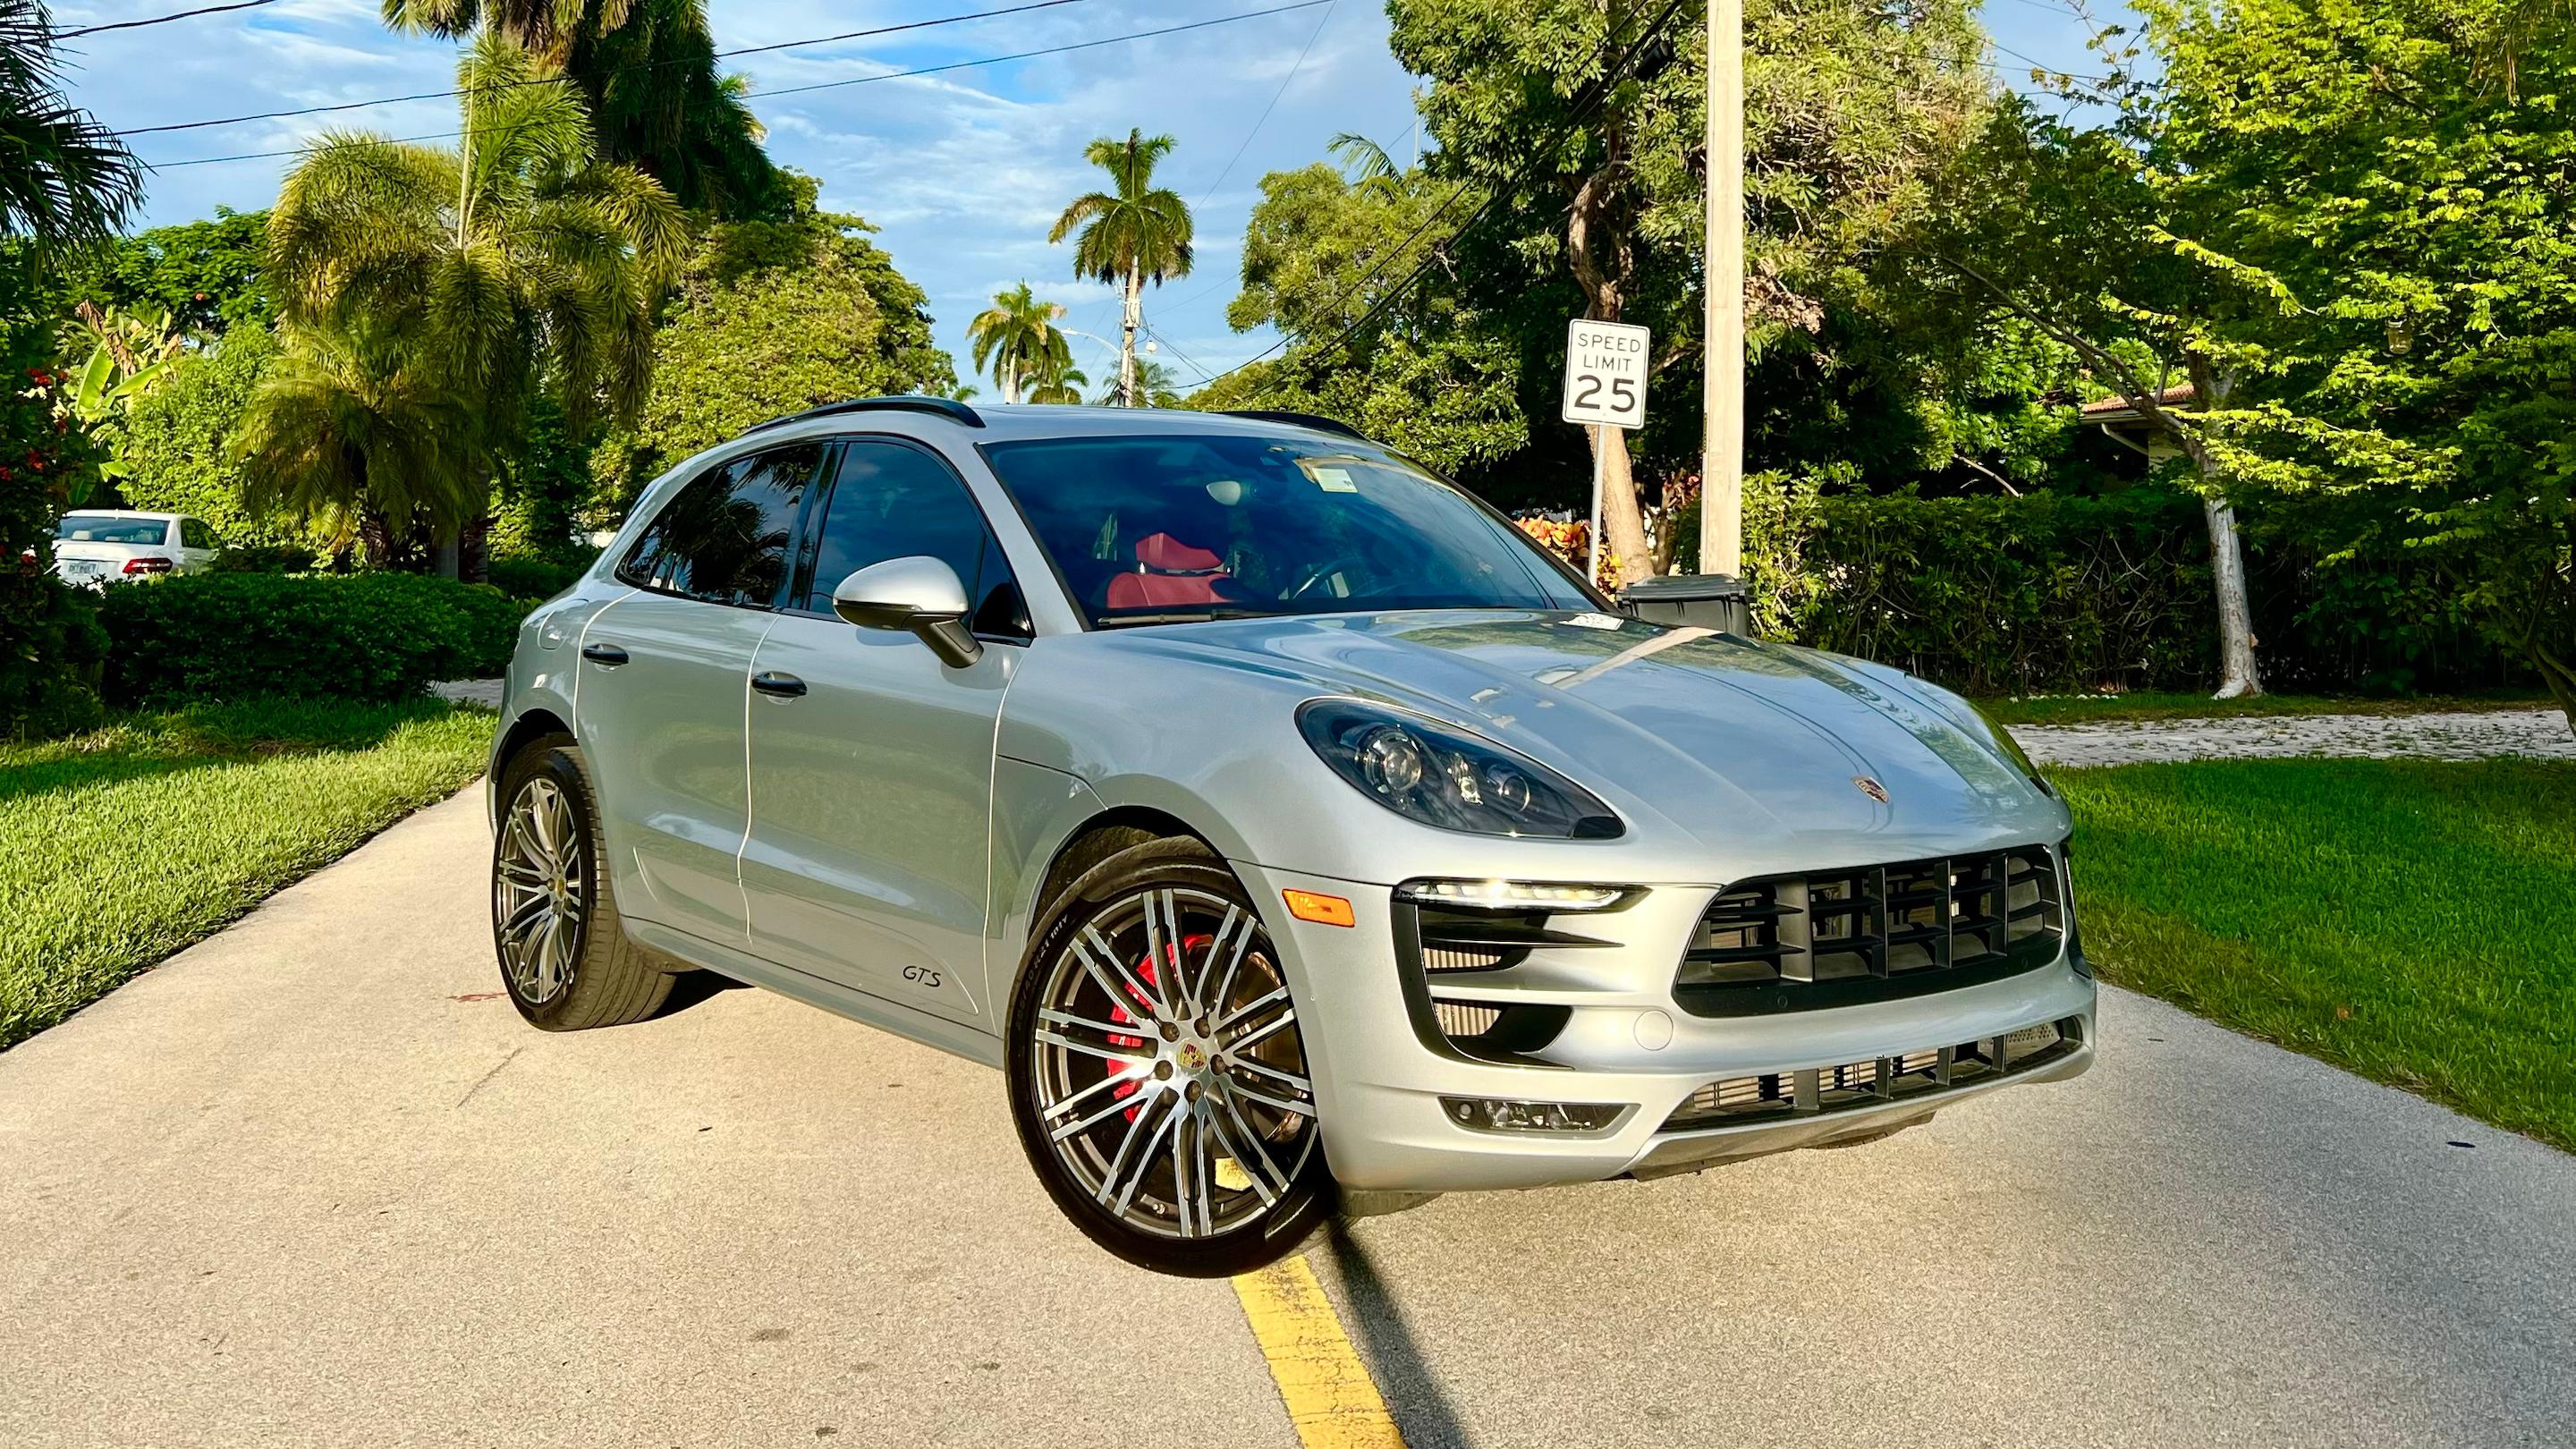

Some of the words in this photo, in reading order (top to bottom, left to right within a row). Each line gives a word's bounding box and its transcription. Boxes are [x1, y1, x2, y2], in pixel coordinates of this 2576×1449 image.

[1578, 333, 1640, 352] SPEED
[1583, 354, 1631, 371] LIMIT
[1574, 374, 1635, 412] 25
[902, 965, 941, 987] GTS
